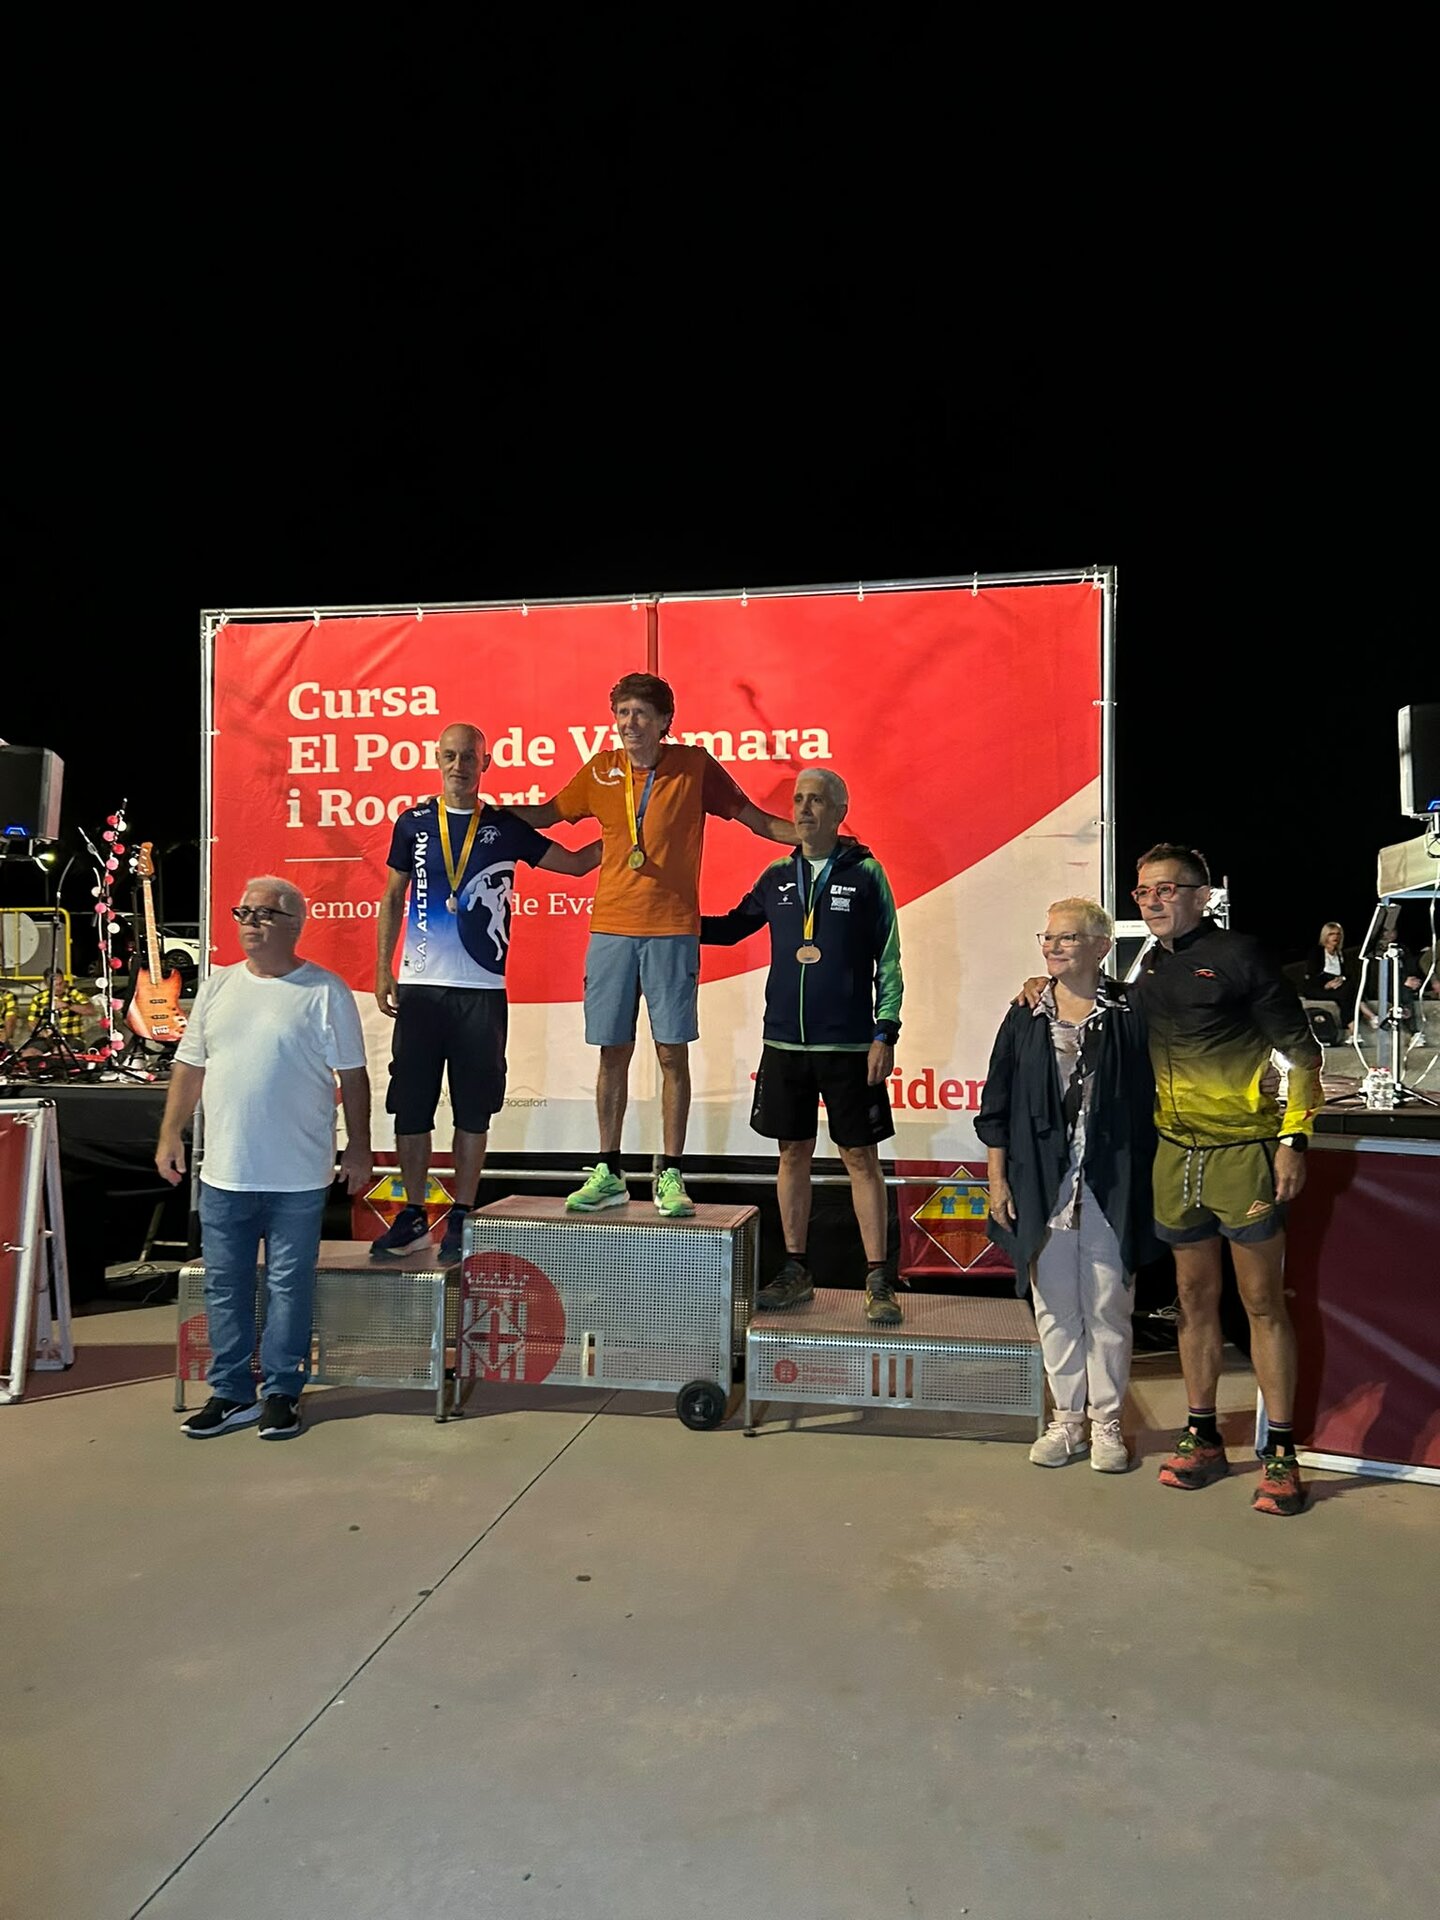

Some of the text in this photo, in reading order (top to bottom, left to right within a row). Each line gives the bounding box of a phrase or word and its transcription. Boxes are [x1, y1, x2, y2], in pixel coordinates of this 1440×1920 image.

[288, 682, 439, 720] Cursa
[288, 734, 340, 774] El
[492, 727, 556, 768] de
[286, 789, 304, 828] i
[511, 893, 539, 915] de
